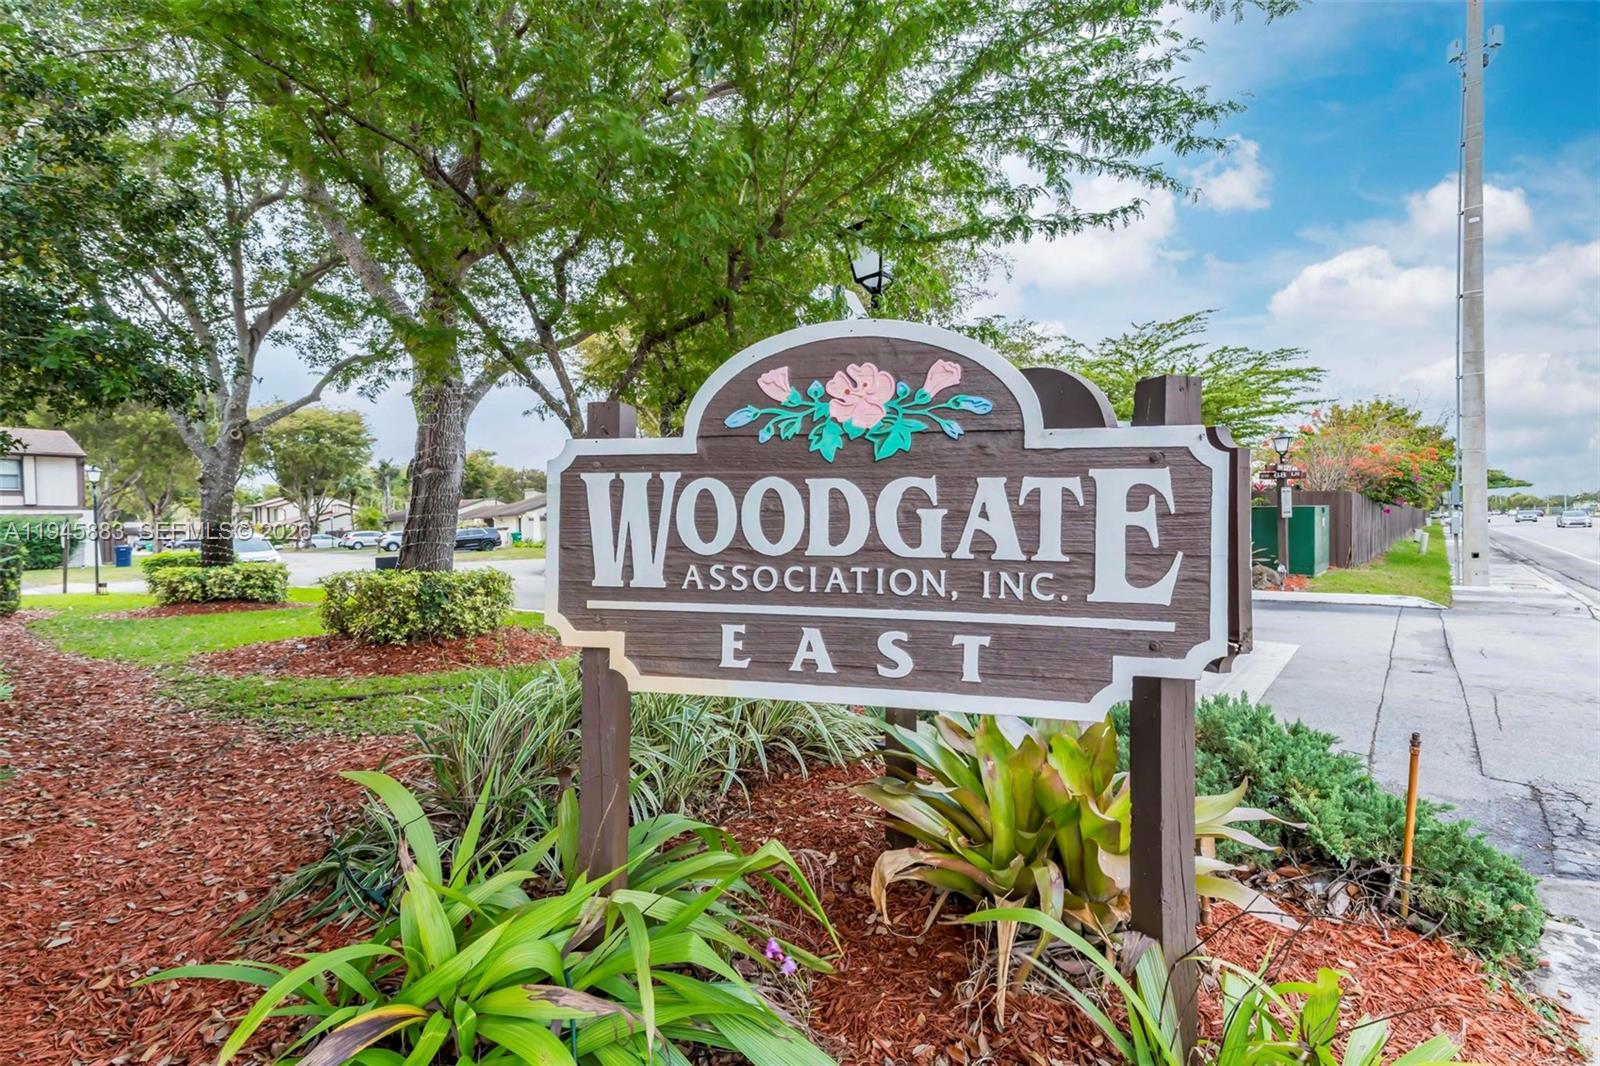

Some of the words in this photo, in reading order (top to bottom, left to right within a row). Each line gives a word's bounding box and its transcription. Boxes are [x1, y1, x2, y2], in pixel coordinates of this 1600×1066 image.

[580, 466, 1183, 606] WOODGATE
[681, 564, 959, 602] ASSOCIATION,
[982, 570, 1069, 602] INC.
[718, 623, 992, 684] EAST
